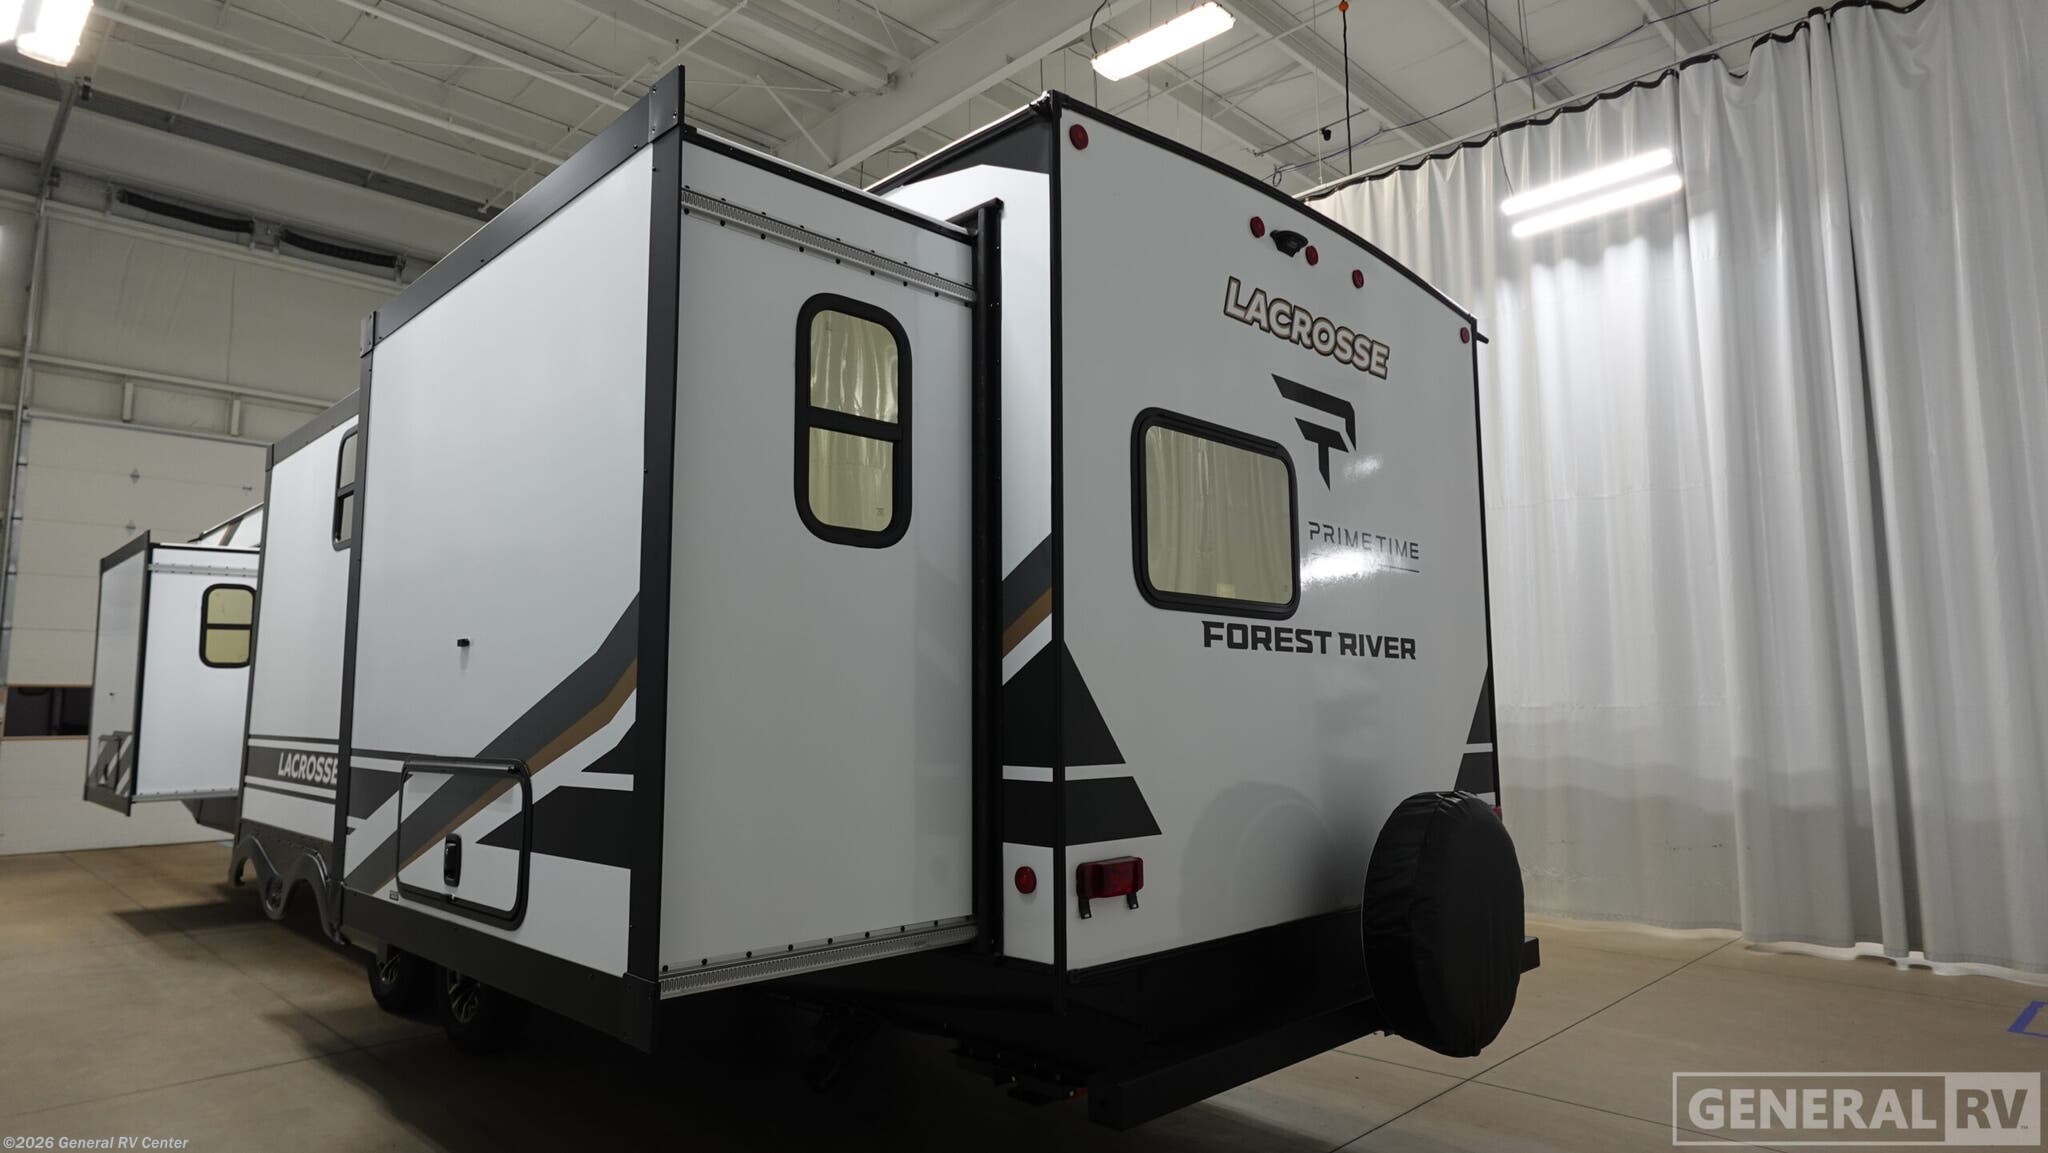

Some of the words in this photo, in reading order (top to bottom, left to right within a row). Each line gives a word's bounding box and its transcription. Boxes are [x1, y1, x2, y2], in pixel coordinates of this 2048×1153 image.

[1224, 276, 1390, 380] LACROSSE
[1201, 620, 1332, 655] FOREST
[1338, 632, 1416, 660] RIVER
[278, 752, 338, 785] LACROSSE
